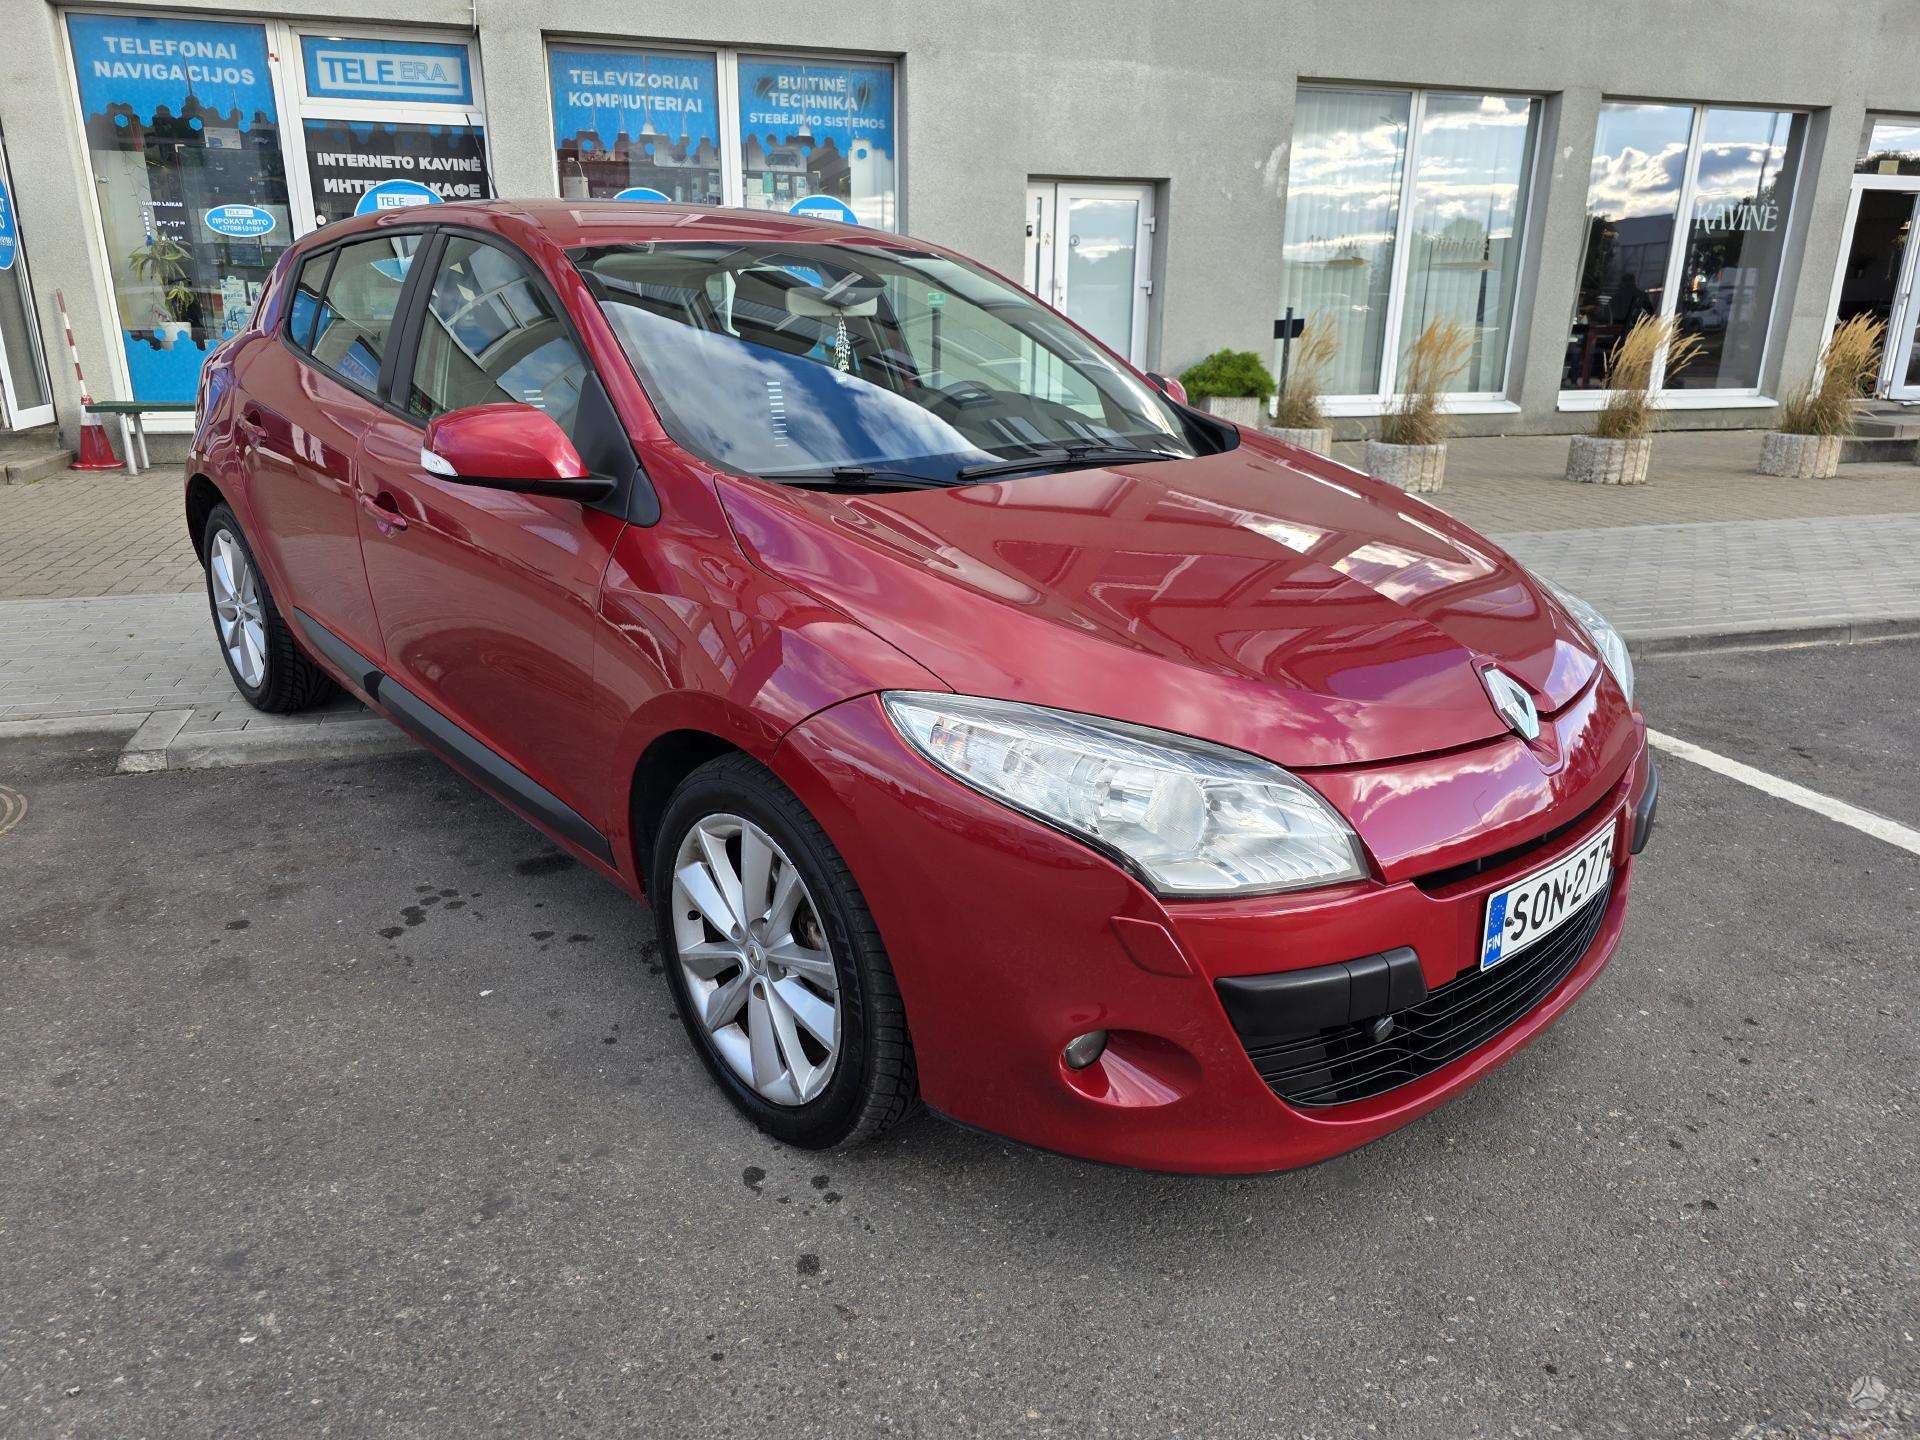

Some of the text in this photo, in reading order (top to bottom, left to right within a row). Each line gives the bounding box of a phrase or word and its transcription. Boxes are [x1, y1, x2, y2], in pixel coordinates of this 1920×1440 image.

[103, 36, 237, 60] TELEFONAI
[94, 60, 256, 85] NAVIGACIJOS
[568, 69, 699, 91] TELEVIZORIAI
[778, 75, 847, 92] BUITINĖ
[568, 92, 703, 113] KOMPIUTERIAI
[768, 92, 859, 111] TECHNIKA
[749, 112, 886, 129] STEBĖJIMO SISTEMOS
[317, 153, 482, 172] INTERNETO KAVINĖ
[430, 181, 482, 198] КАФЕ
[212, 217, 244, 225] ПРОКАТ
[1695, 199, 1779, 234] KAVINĖ
[1511, 835, 1611, 941] SON-277
[1486, 933, 1502, 954] FIN
